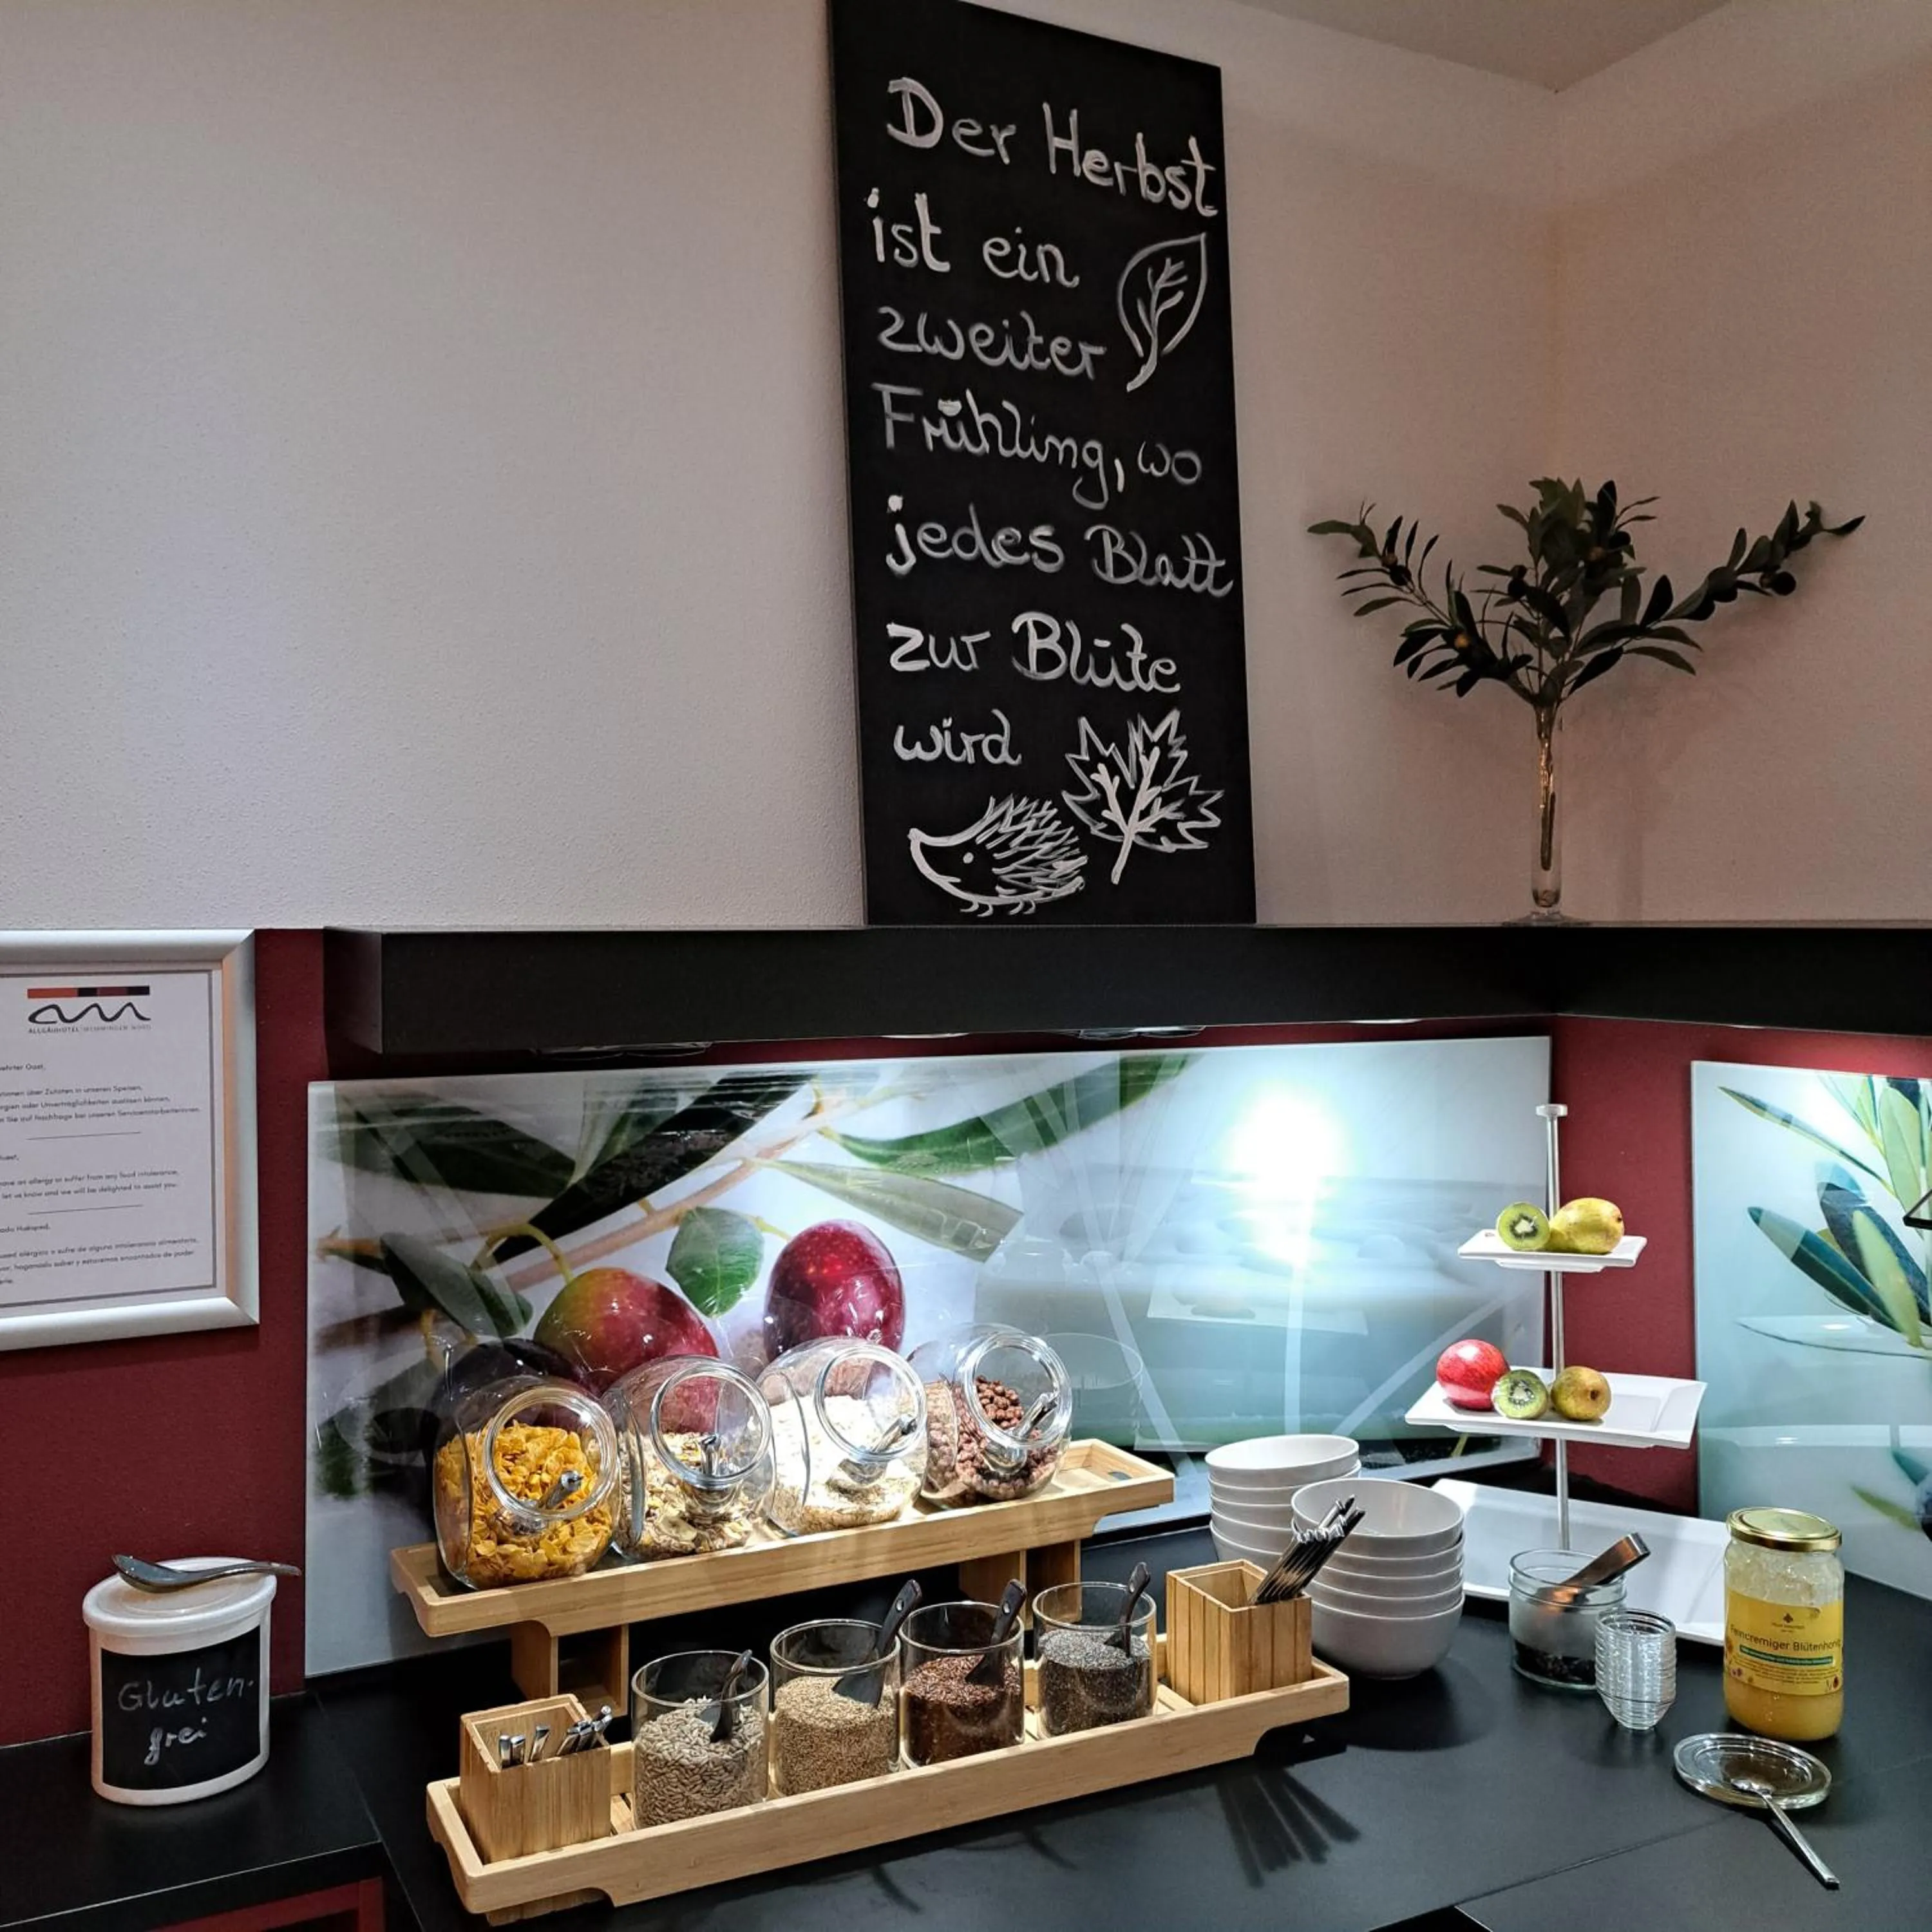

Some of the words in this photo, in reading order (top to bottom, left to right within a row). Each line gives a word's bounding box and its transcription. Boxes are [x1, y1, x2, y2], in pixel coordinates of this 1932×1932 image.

[887, 77, 1016, 164] Der
[1042, 102, 1218, 216] Herbst
[864, 187, 951, 272] ist
[982, 227, 1080, 287] ein
[877, 306, 1107, 379] zweiter
[871, 382, 1124, 509] Frühling,
[1137, 441, 1202, 484] wo
[885, 495, 1065, 574] jedes
[1084, 524, 1234, 597] Blatt
[1011, 611, 1180, 693] Blüte
[893, 709, 1022, 766] wird
